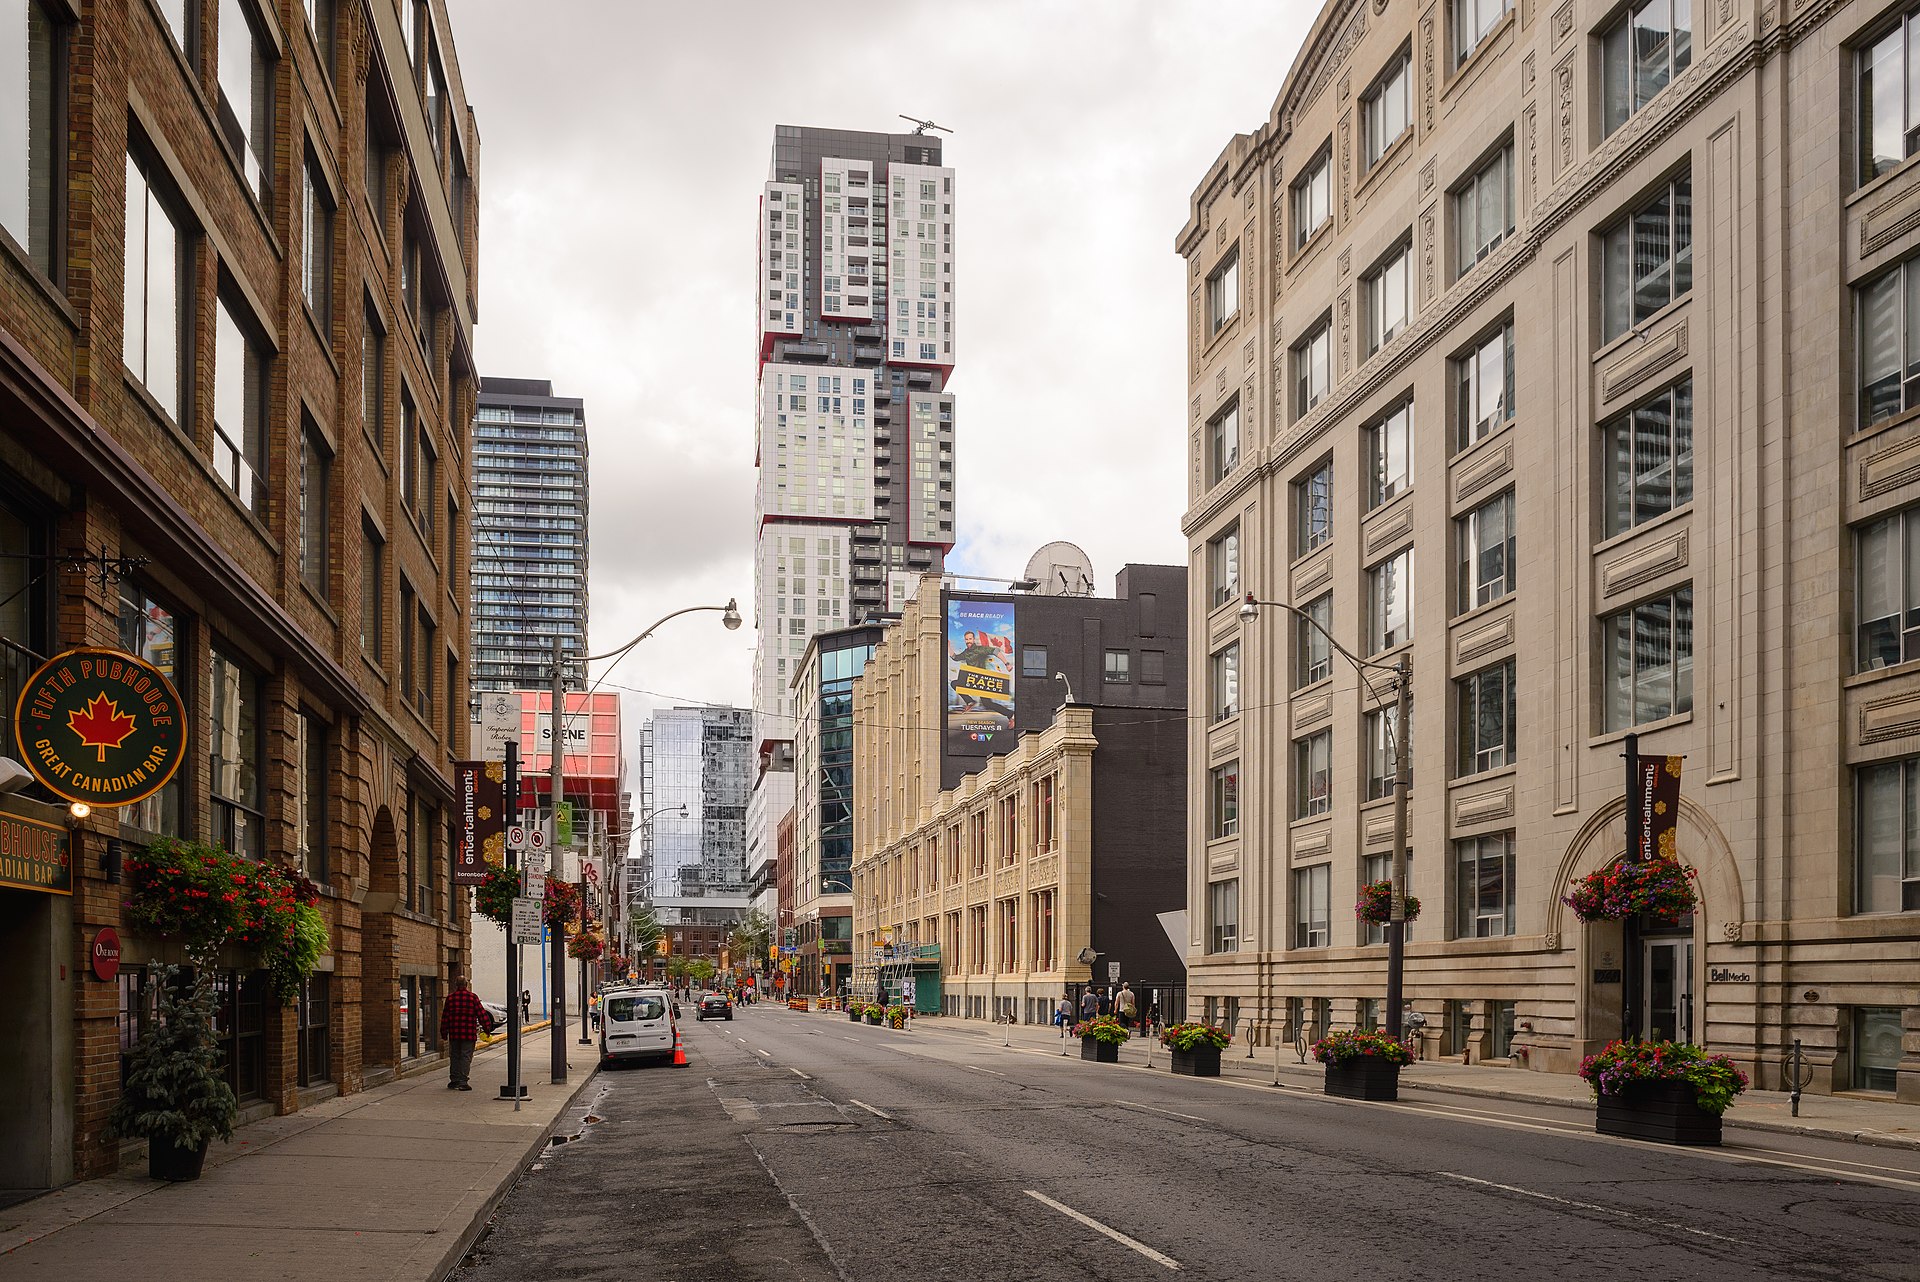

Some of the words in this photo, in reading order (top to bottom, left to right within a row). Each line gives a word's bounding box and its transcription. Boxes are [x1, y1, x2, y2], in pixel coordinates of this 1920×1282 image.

[966, 676, 1003, 689] RACE
[966, 683, 1003, 693] CANADA
[980, 675, 1004, 683] AMAZING
[32, 667, 77, 720] FIFTH
[80, 659, 172, 727] PUBHOUSE
[486, 725, 517, 734] Imperial
[542, 728, 586, 740] SENE
[35, 739, 72, 779] GREAT
[71, 768, 147, 793] CANADIAN
[142, 745, 168, 773] BAR
[463, 769, 475, 865] entertainment
[1642, 764, 1655, 860] entertainment
[0, 820, 59, 865] BHOUSE
[34, 866, 53, 885] BAR
